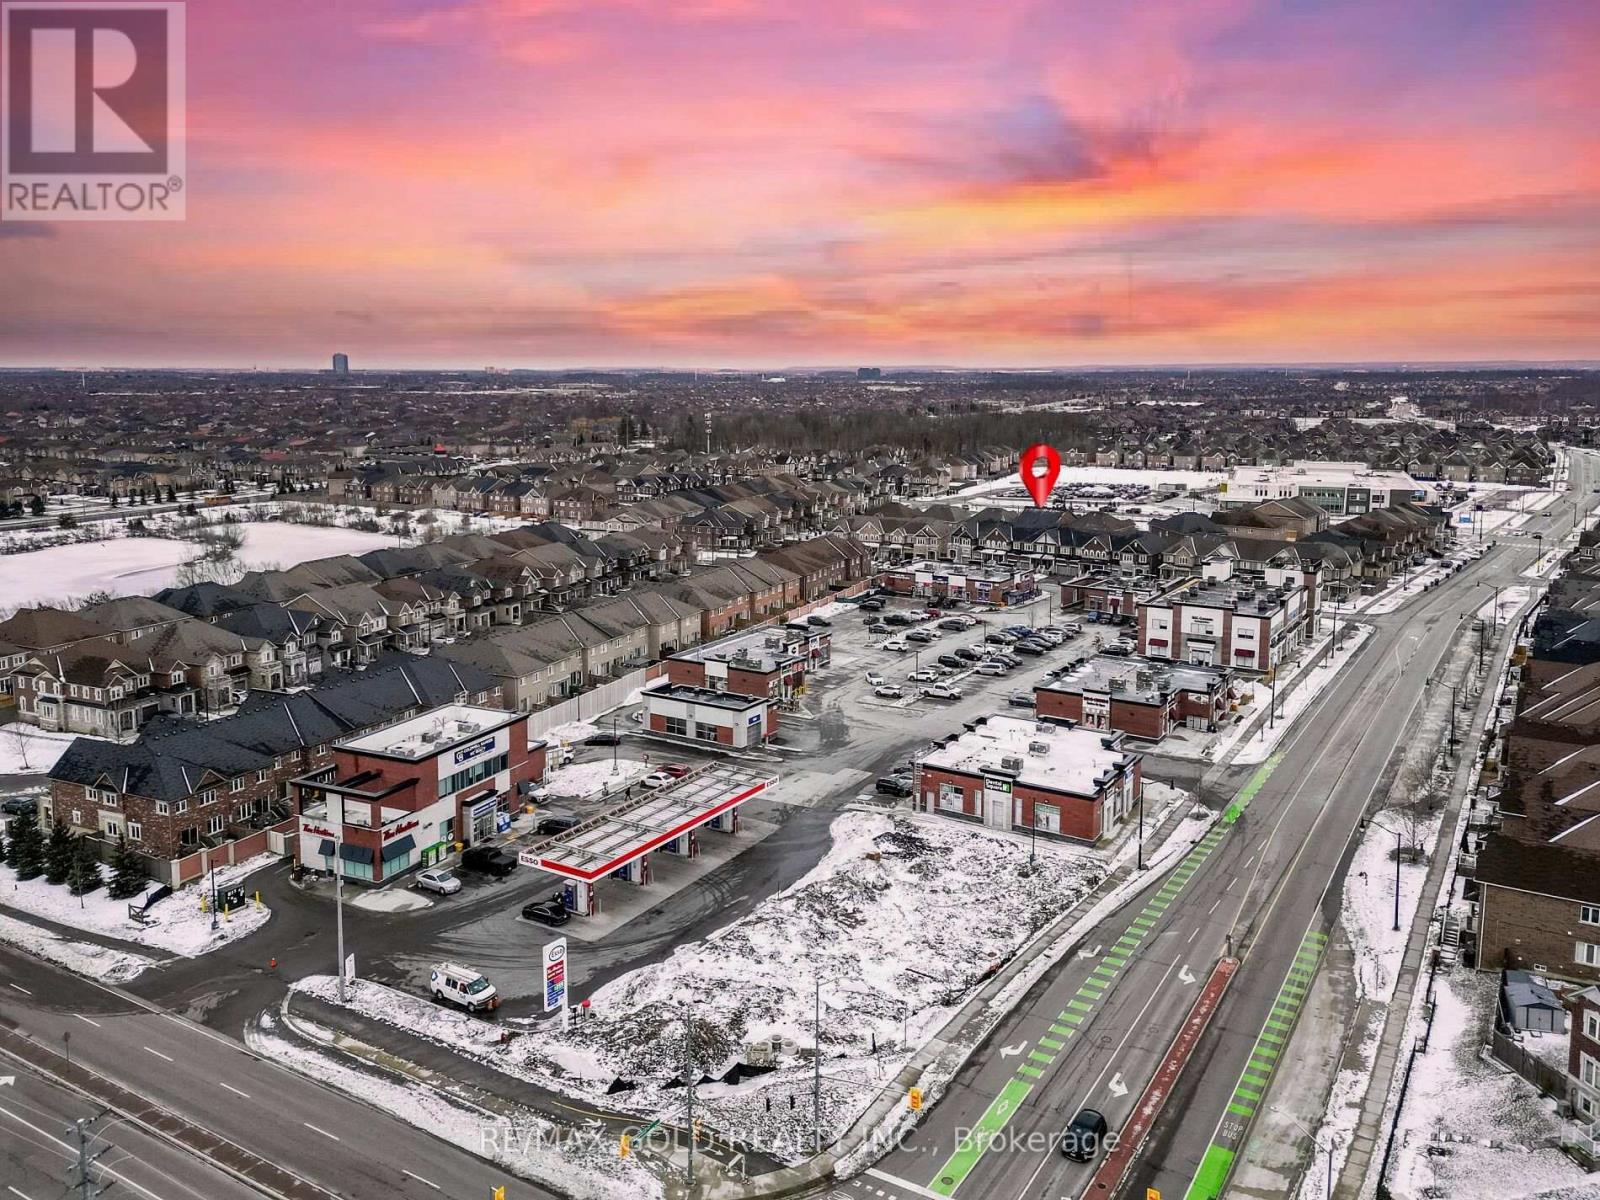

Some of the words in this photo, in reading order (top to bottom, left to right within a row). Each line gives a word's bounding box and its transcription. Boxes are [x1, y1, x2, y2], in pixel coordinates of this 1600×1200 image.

[302, 823, 313, 833] Tim
[313, 825, 335, 837] Hortons
[383, 828, 395, 841] Tim
[395, 820, 419, 836] Hortons
[521, 855, 538, 866] ESSO
